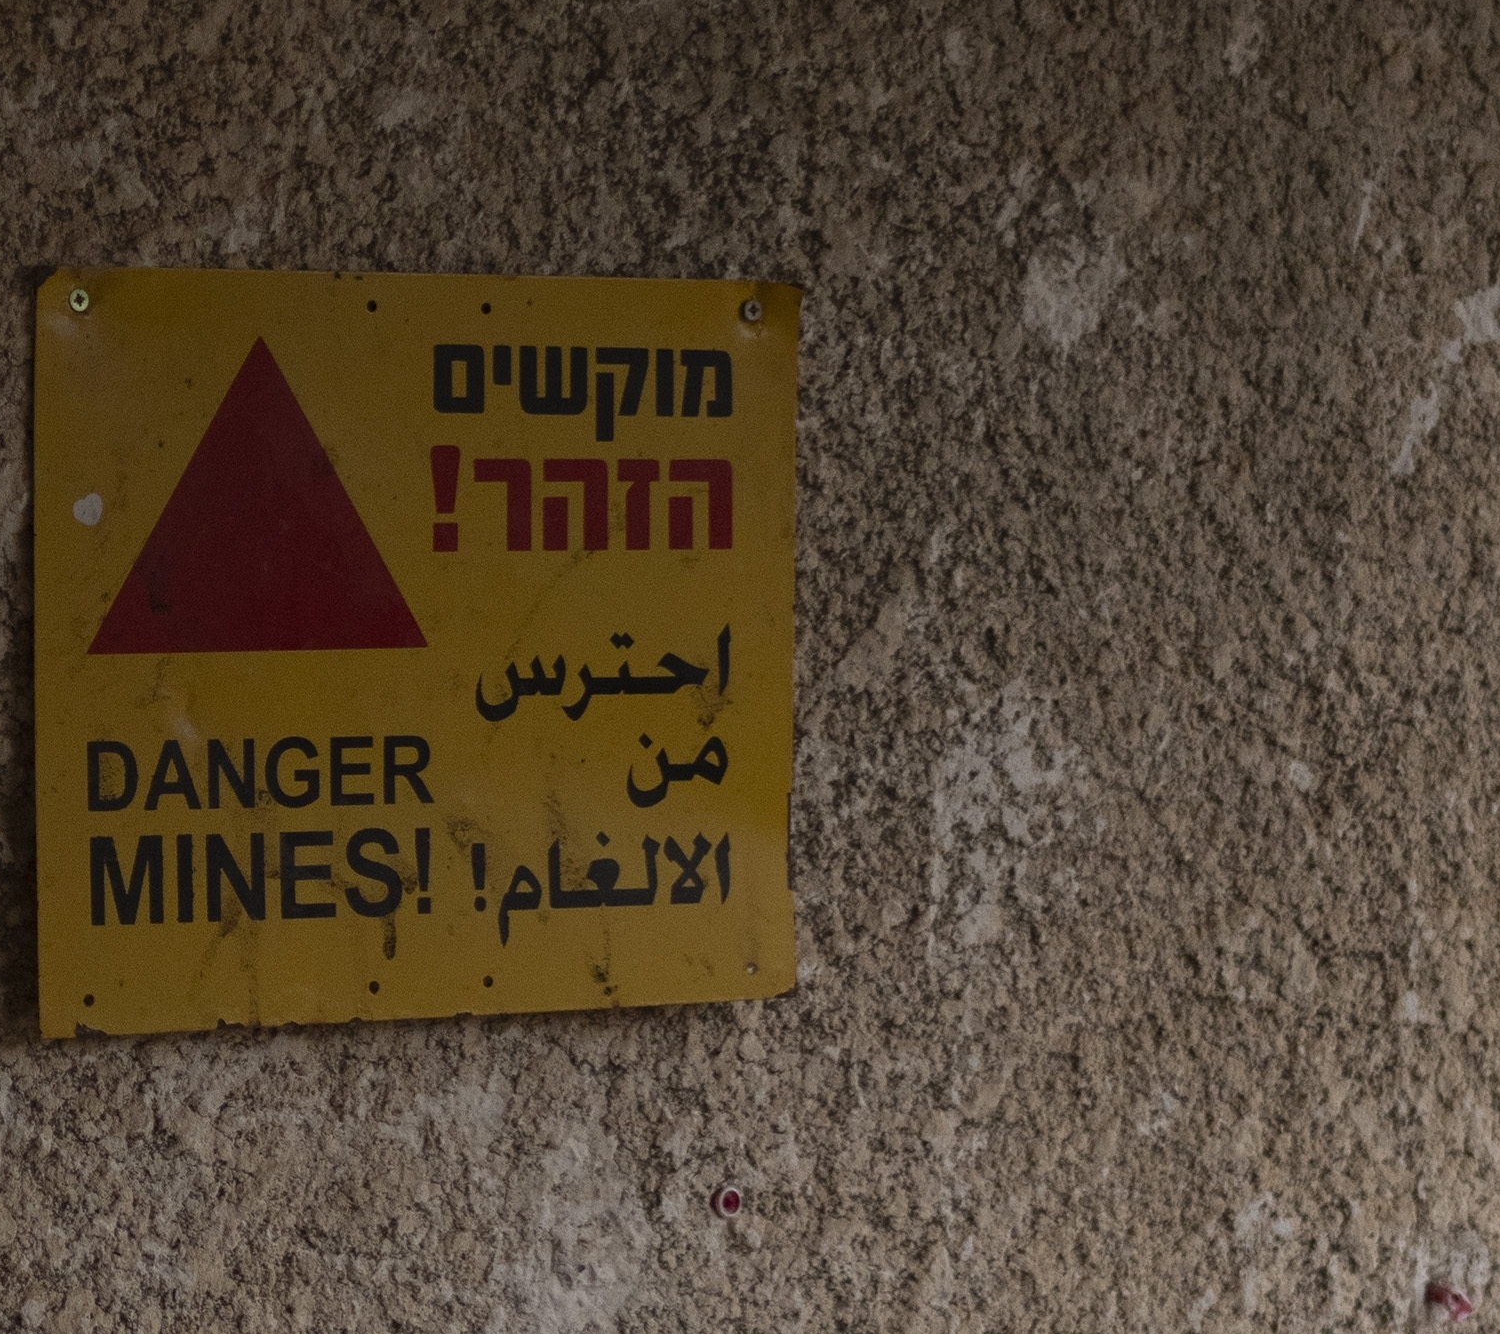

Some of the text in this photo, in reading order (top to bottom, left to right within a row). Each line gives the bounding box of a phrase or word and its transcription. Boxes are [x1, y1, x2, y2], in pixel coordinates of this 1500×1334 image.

[434, 344, 733, 442] מוקשים
[430, 445, 733, 552] הזהר!
[475, 625, 731, 721] احترس
[87, 735, 434, 811] DANGER
[627, 732, 728, 806] من
[89, 828, 430, 926] MINES!
